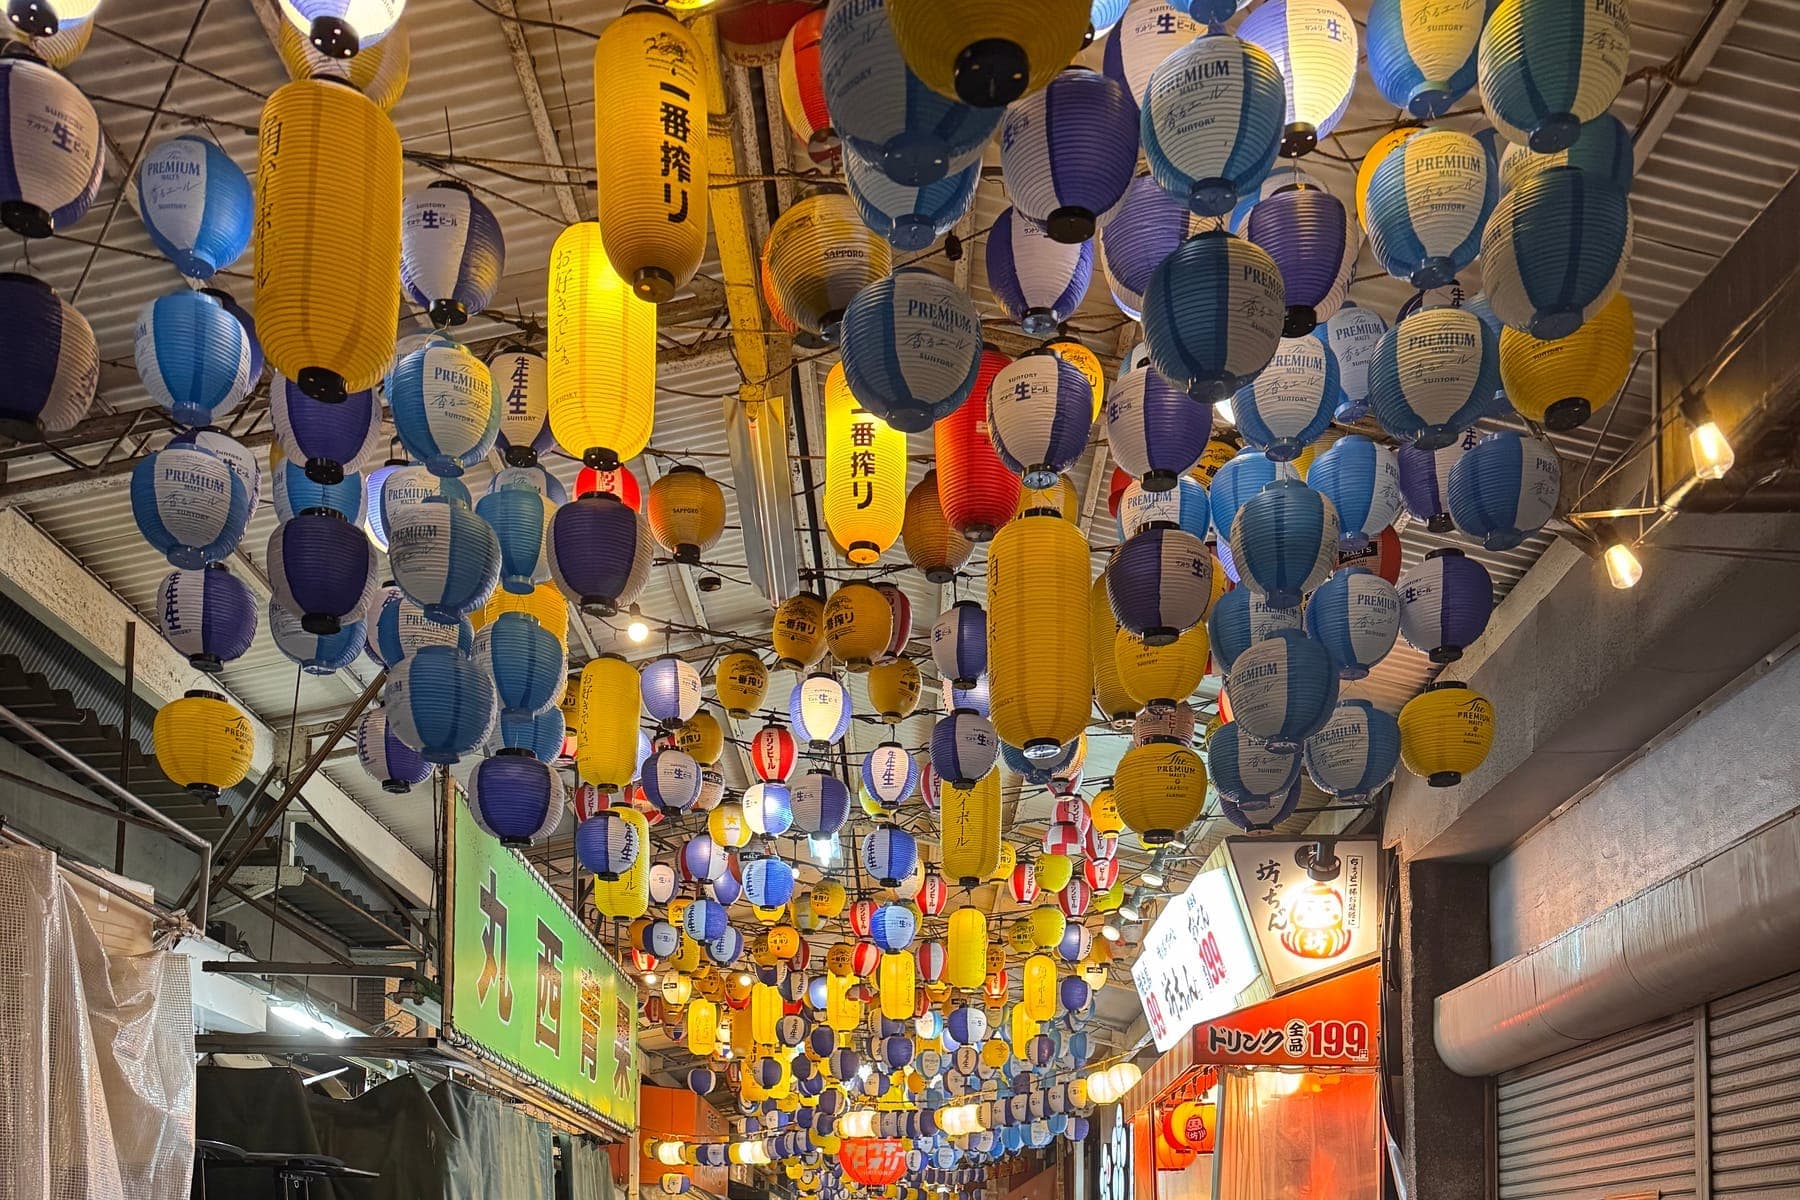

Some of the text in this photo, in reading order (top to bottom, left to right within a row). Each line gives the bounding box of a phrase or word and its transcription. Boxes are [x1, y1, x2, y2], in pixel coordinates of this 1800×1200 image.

[1159, 59, 1231, 98] PREMIUM
[1176, 116, 1216, 135] SUNTORY
[659, 81, 691, 225] 一番搾り
[147, 160, 200, 178] PREMIUM
[1416, 155, 1481, 174] PREMIUM
[1430, 203, 1466, 212] SUNTORY
[823, 249, 864, 259] SAPPORO
[907, 298, 973, 334] PREMIUM
[1335, 323, 1382, 341] PREMIUM
[1408, 332, 1476, 349] PREMIUM
[920, 352, 955, 370] SUNTORY
[1271, 353, 1324, 372] PREMIUM
[434, 365, 490, 398] PREMIUM
[506, 355, 531, 415] 生生生
[1423, 376, 1461, 385] SUNTORY
[444, 409, 476, 424] SUNTORY
[850, 408, 877, 510] 一番搾り
[165, 468, 226, 494] PREMIUM
[388, 488, 433, 501] PREMIUM
[672, 507, 700, 515] SAPPORO
[1357, 593, 1398, 609] PREMIUM
[779, 618, 817, 635] 一番搾り
[728, 674, 765, 689] 一番搾り
[1233, 662, 1278, 686] PREMIUM
[1457, 711, 1491, 724] PREMIUM
[1315, 722, 1361, 745] PREMIUM
[1156, 764, 1197, 776] PREMIUM
[1256, 859, 1288, 932] 坊っちゃん
[1208, 1026, 1284, 1054] ドリンク
[1288, 1022, 1306, 1053] 全品
